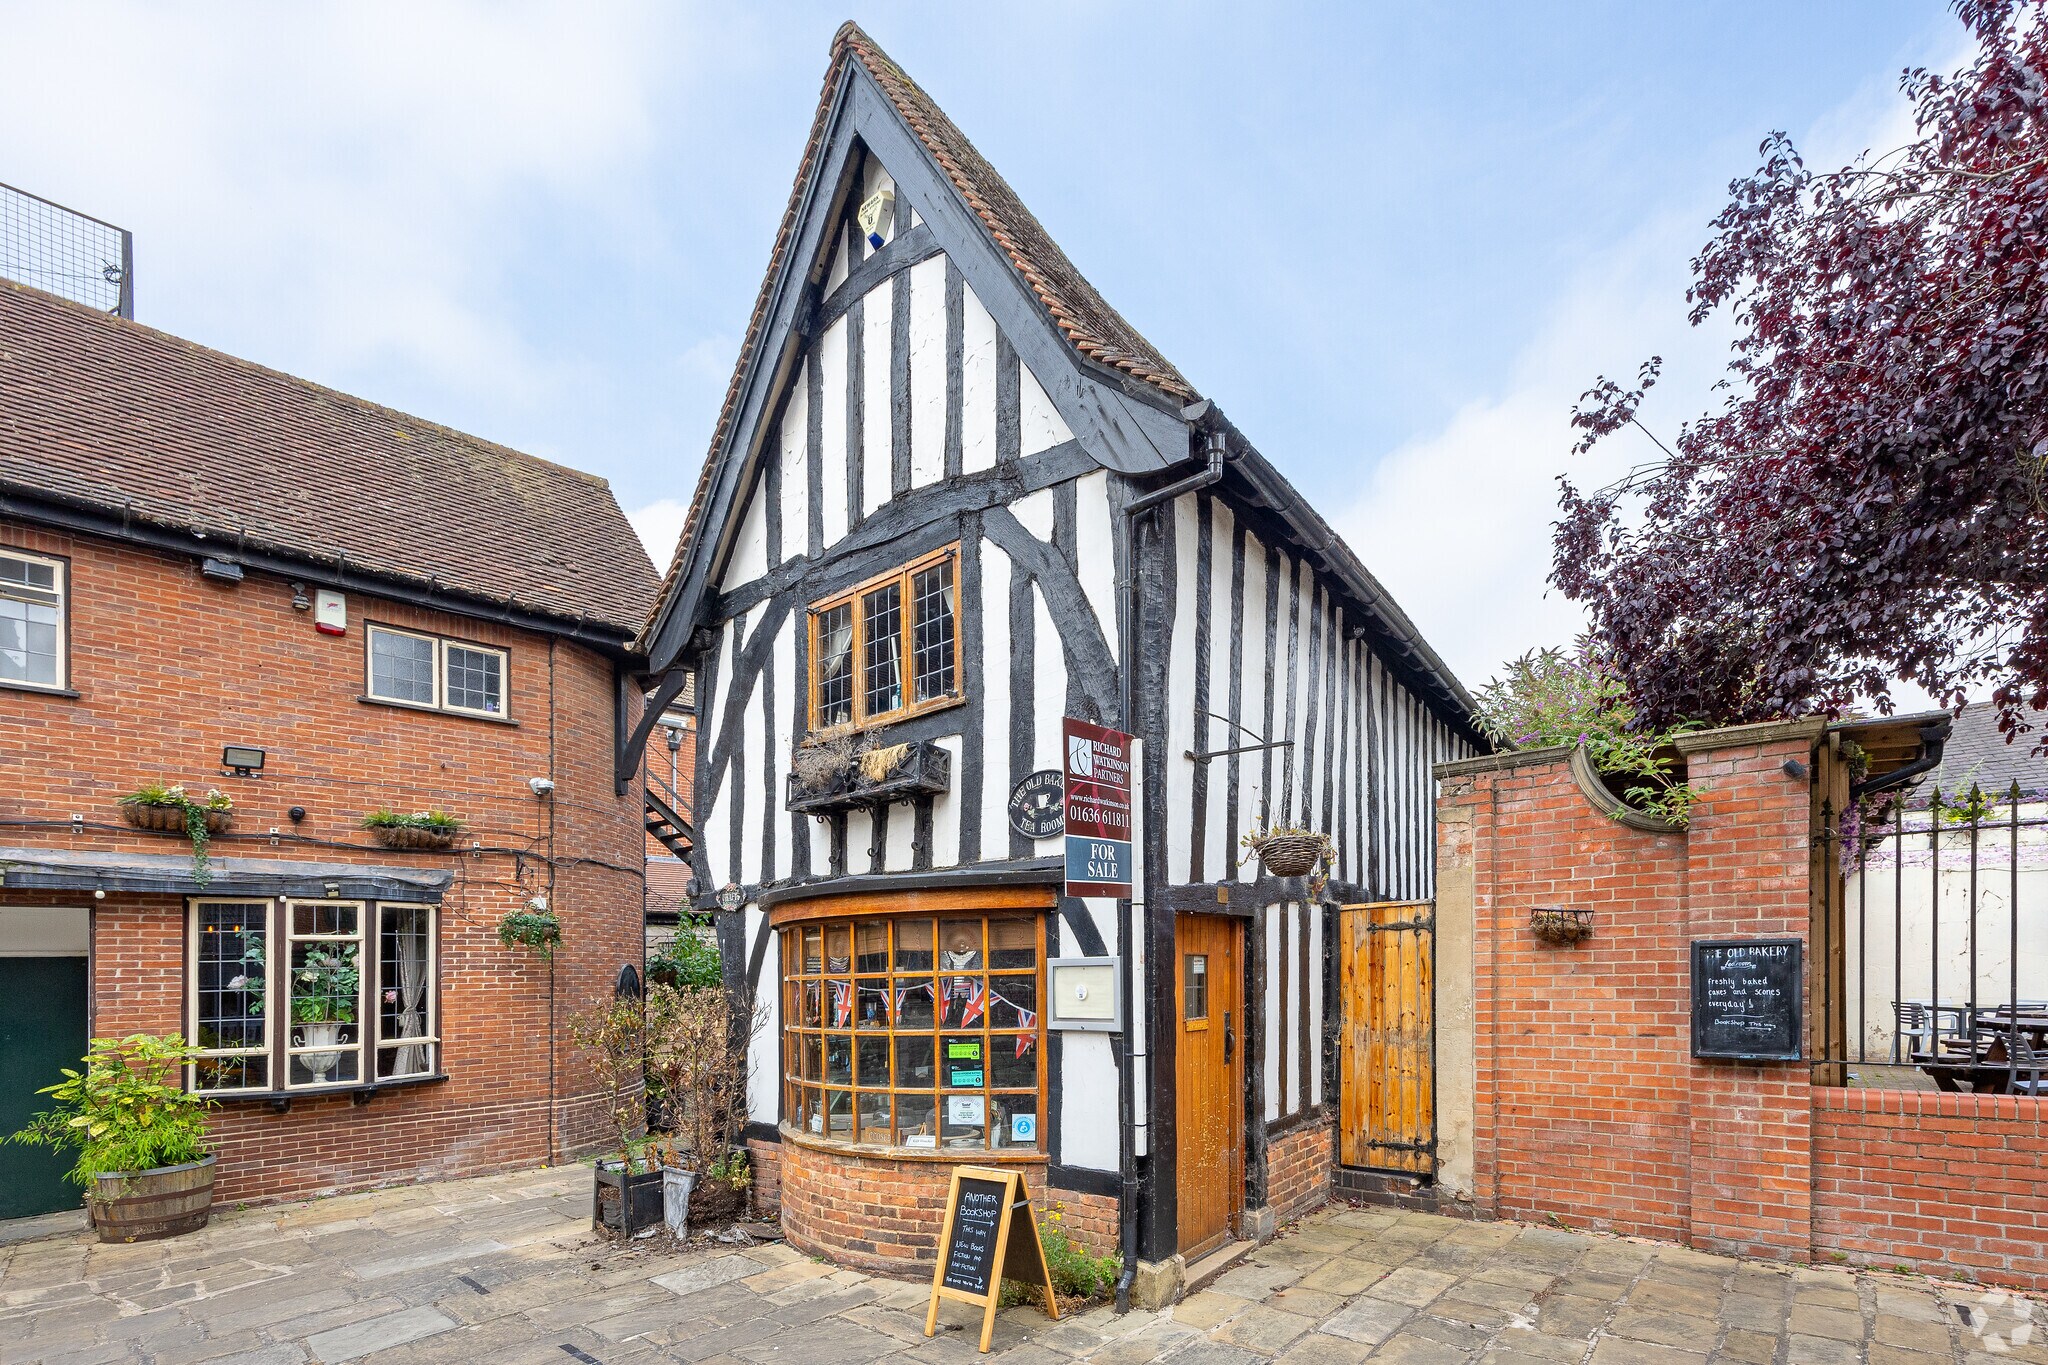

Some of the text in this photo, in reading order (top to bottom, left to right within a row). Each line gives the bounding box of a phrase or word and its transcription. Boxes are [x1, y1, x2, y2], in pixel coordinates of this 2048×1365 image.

[1092, 740, 1122, 758] RICHARD
[1092, 754, 1130, 772] WATKINSON
[1093, 768, 1124, 784] PARTNERS
[1011, 786, 1027, 808] THE
[1026, 775, 1043, 791] OLD
[1020, 817, 1035, 833] TEA
[1070, 805, 1130, 828] 01636 611811
[1090, 842, 1115, 861] FOR
[1087, 860, 1118, 879] SALE
[1727, 947, 1746, 958] OLD
[1748, 945, 1790, 957] BAKERY
[1708, 976, 1768, 989] freshly baked
[1754, 988, 1781, 996] scones
[964, 1191, 998, 1205] ANOTHER
